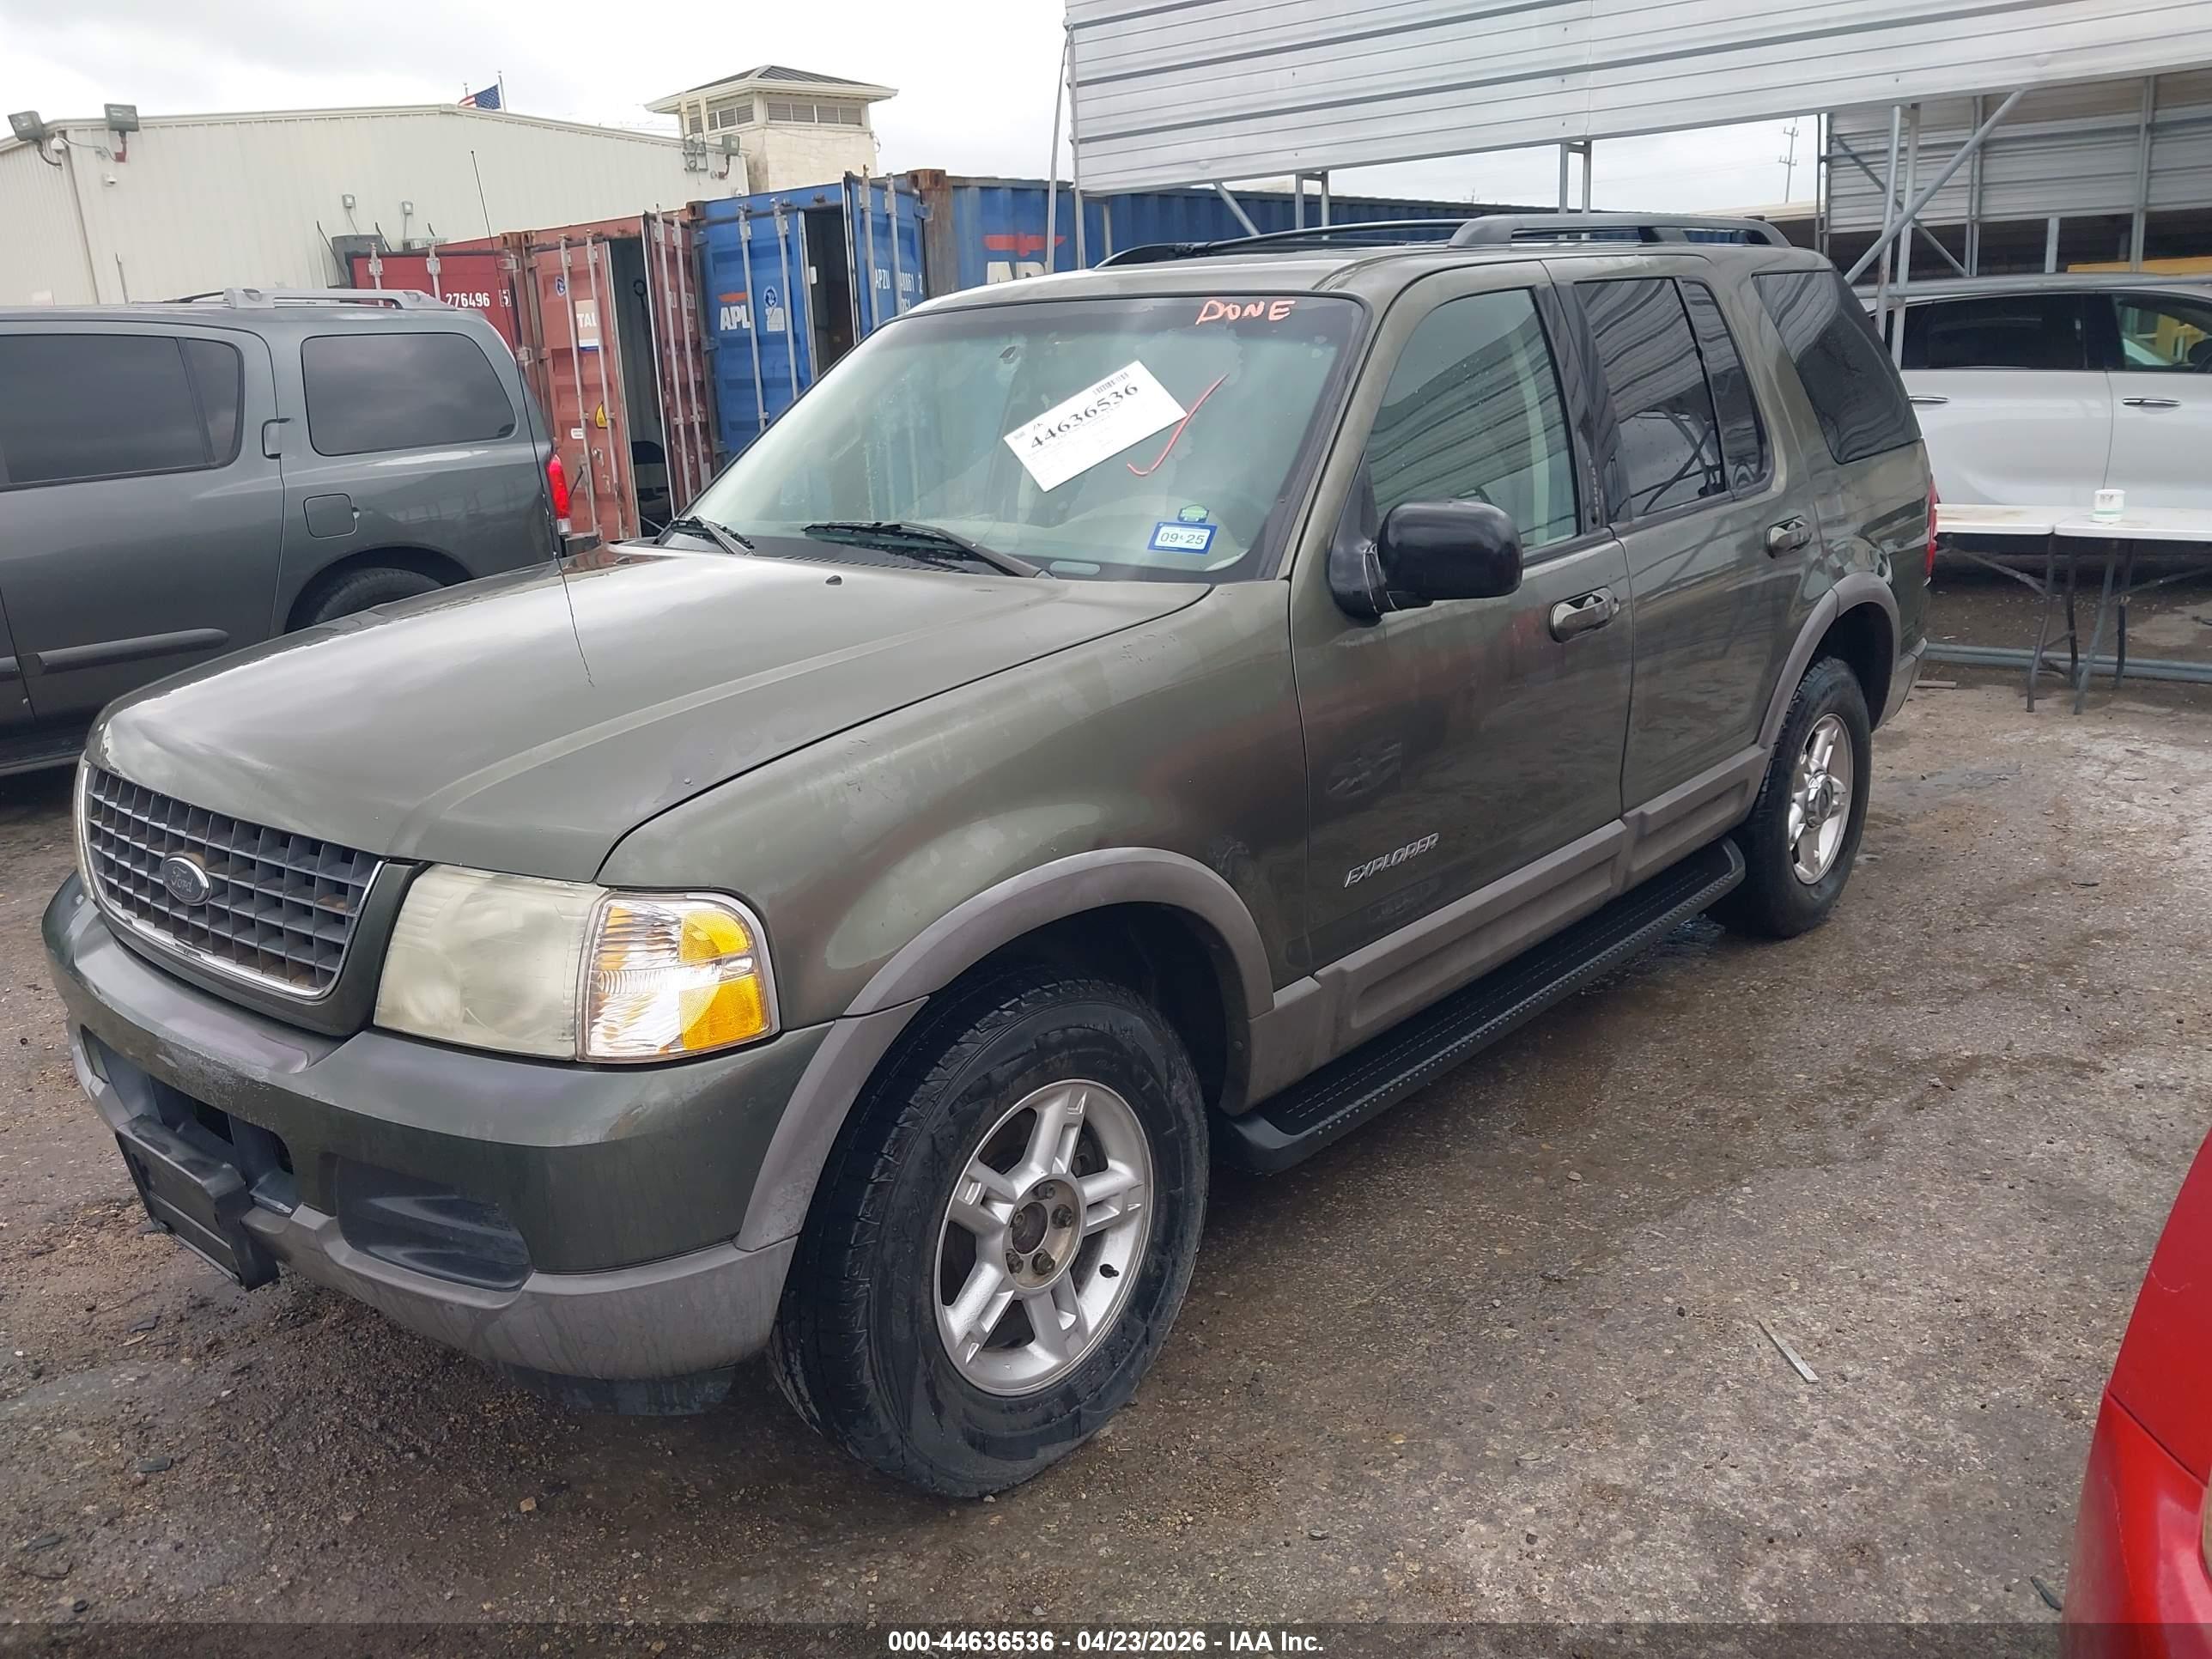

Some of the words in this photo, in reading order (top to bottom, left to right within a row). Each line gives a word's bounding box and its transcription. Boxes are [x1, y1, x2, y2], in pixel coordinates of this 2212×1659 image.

[720, 305, 750, 331] APL
[1194, 299, 1296, 325] DONE
[1030, 384, 1139, 449] 44636536
[1160, 532, 1179, 543] 09
[1185, 534, 1205, 545] 25
[1343, 832, 1439, 888] EXPLORER
[171, 866, 194, 893] Ford
